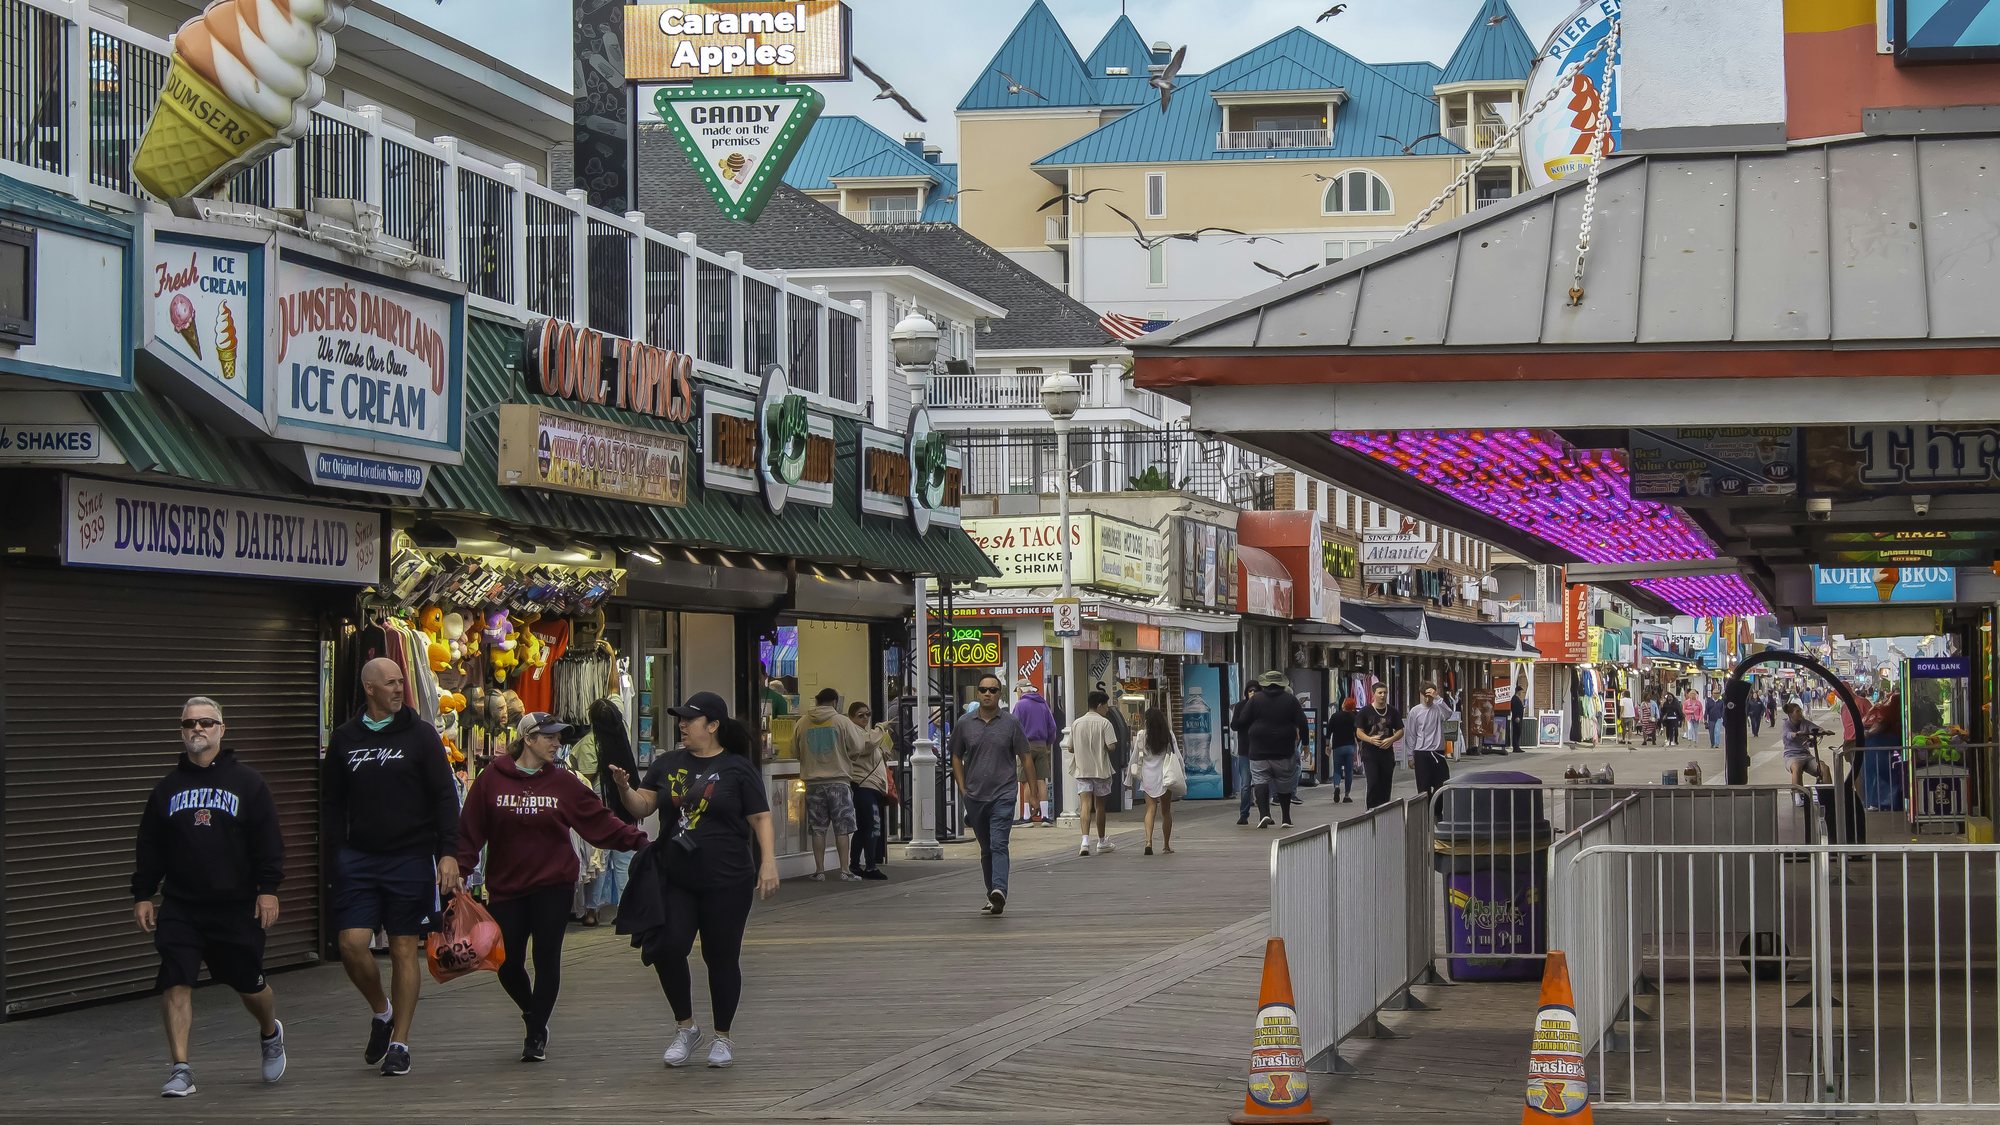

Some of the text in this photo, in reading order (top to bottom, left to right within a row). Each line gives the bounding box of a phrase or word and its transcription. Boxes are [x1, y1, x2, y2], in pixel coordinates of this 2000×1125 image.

[658, 4, 806, 36] Caramel
[1549, 16, 1592, 60] PIER
[670, 37, 796, 74] Apples
[690, 105, 781, 125] CANDY
[702, 123, 770, 137] made on the
[711, 135, 761, 149] premises
[1550, 162, 1576, 175] KOHR
[154, 251, 200, 298] Fresh
[213, 255, 235, 274] ICE
[200, 275, 247, 297] CREAM
[360, 291, 445, 396] DAIRYLAND
[318, 335, 408, 377] We Make Our Own
[536, 317, 693, 424] COOL TOPICS
[291, 362, 426, 431] ICE CREAM
[16, 431, 92, 451] SHAKES
[1853, 425, 2000, 480] Thr
[319, 456, 421, 485] Our Original Location Since 1939
[1634, 460, 1707, 471] Value Combo
[1770, 466, 1788, 476] VIP
[1721, 480, 1739, 490] VIP
[77, 490, 104, 521] Since
[79, 514, 105, 550] 1939
[114, 497, 349, 567] DUMSERS' DAIRYLAND
[355, 521, 373, 547] Since
[1019, 525, 1081, 547] TACS
[356, 542, 374, 572] 1939
[1014, 552, 1073, 562] CHICKE
[1366, 545, 1428, 560] Atlantic
[1014, 564, 1063, 574] SHRIM
[1366, 566, 1402, 575] HOTEL
[1819, 567, 1872, 585] KOHR
[1015, 606, 1040, 614] CAKE
[930, 642, 999, 664] TACOS
[1019, 649, 1043, 681] Fried
[1916, 663, 1940, 671] ROYAL
[168, 787, 240, 817] MARYLAND
[496, 794, 559, 809] SALISBURY
[1541, 1019, 1571, 1030] MAINTAIN
